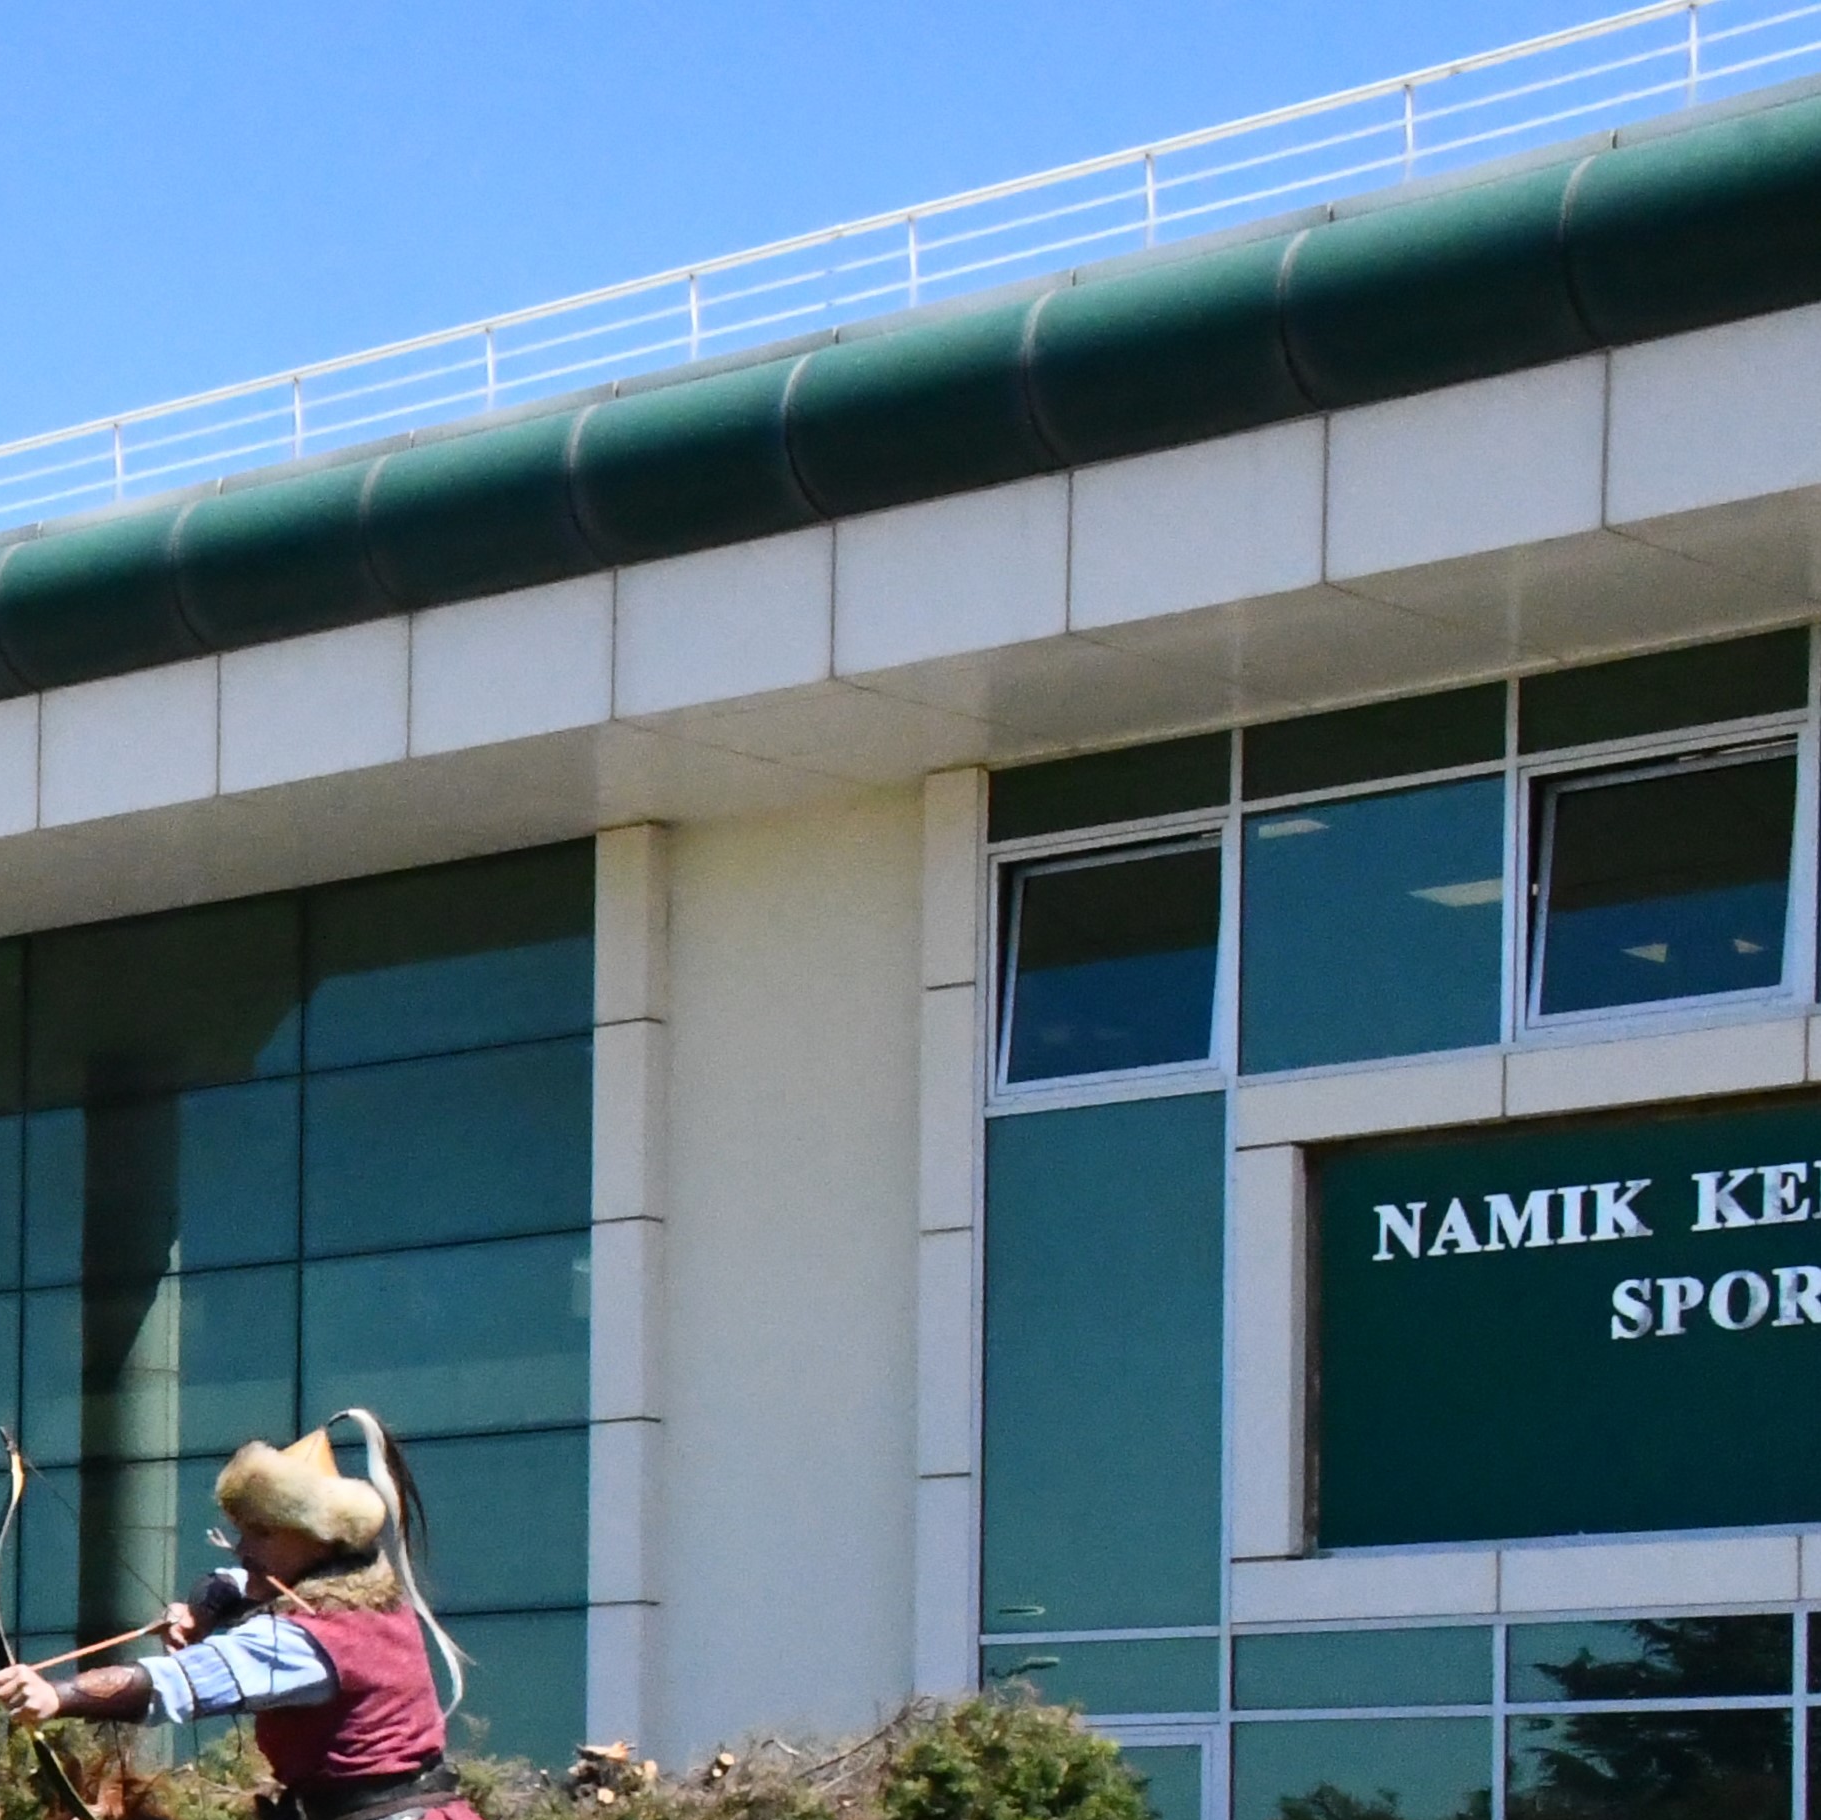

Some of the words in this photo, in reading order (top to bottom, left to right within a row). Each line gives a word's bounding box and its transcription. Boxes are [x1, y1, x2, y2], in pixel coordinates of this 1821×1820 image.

[1372, 1179, 1653, 1261] NAMIK
[1690, 1160, 1821, 1233] KE
[1611, 1265, 1821, 1341] SPOR
